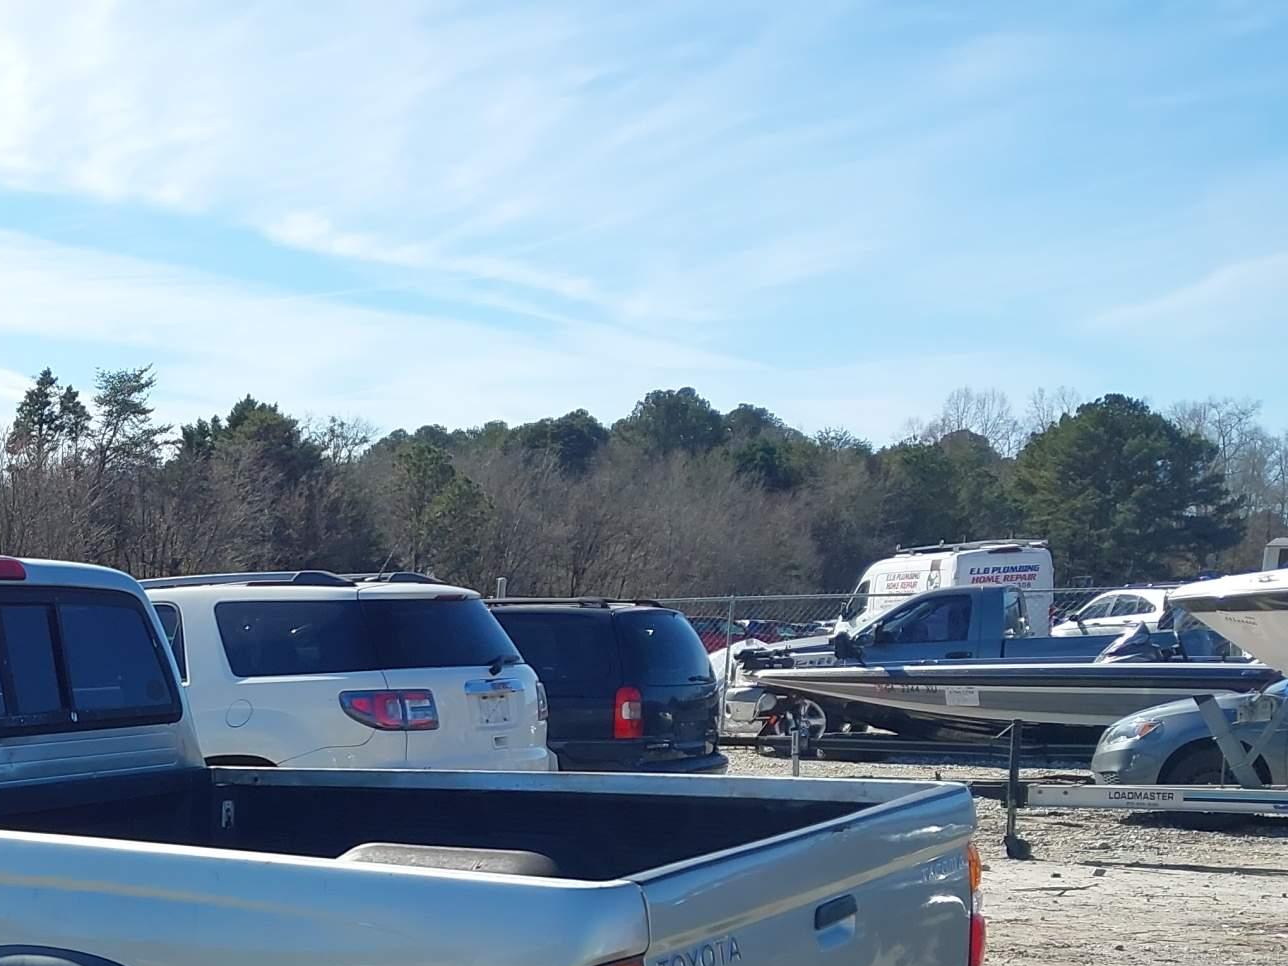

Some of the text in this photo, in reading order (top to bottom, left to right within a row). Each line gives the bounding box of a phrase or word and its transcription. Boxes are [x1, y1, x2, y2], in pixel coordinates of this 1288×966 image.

[971, 573, 1037, 584] HOME REPAIR
[1108, 791, 1174, 801] LOADMASTER
